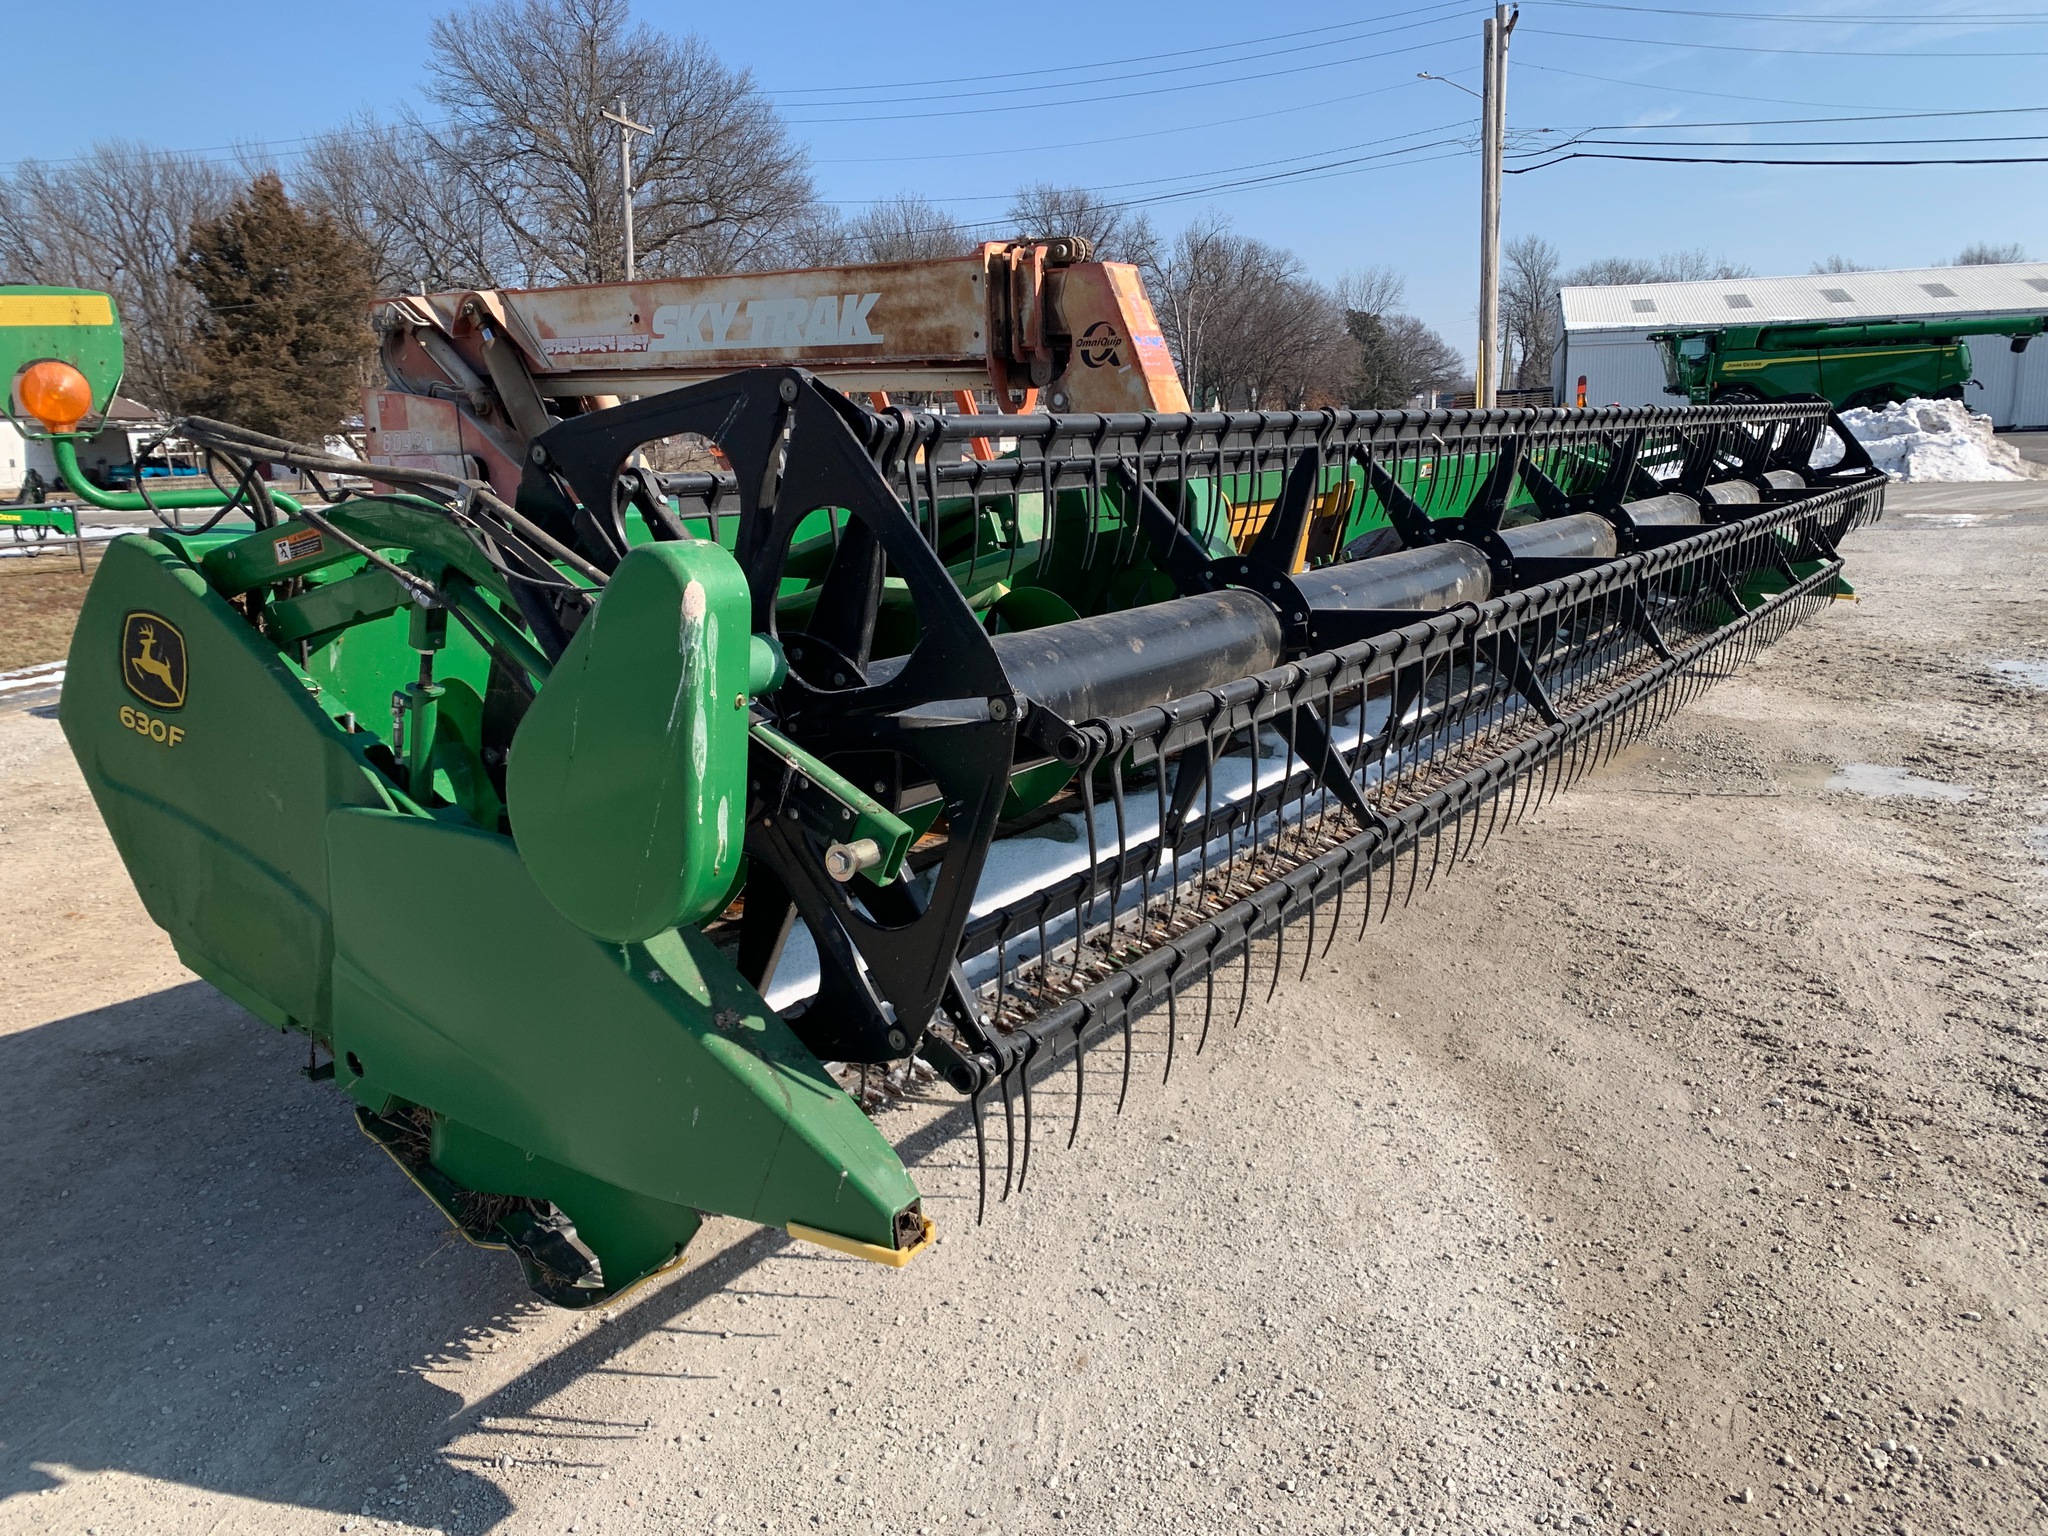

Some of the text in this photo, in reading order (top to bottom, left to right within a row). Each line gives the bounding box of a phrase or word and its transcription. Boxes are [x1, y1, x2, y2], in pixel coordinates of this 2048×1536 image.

[1076, 336, 1122, 348] OmniQuip
[383, 432, 424, 453] 8042
[120, 705, 185, 747] 630F
